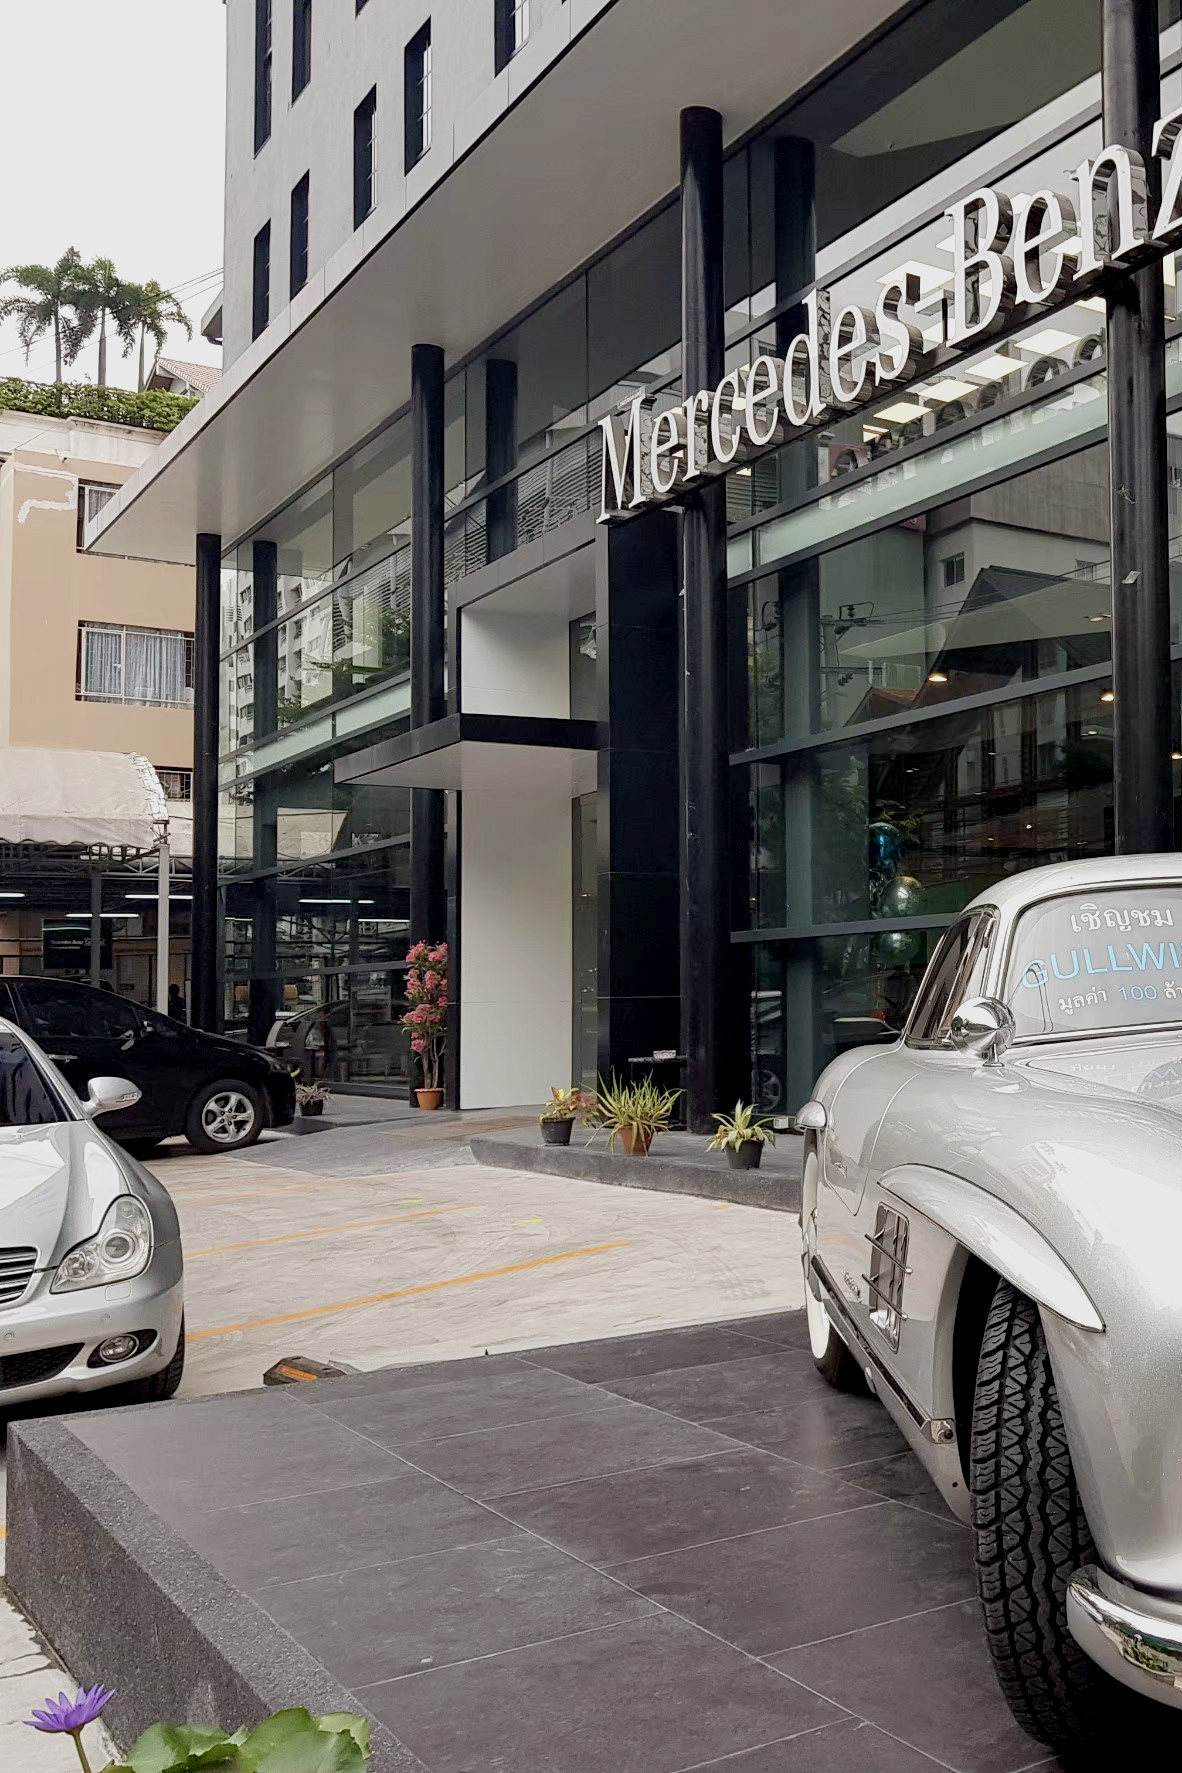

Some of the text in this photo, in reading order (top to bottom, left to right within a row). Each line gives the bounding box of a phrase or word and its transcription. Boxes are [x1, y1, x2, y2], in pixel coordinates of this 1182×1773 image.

[1070, 903, 1174, 933] เชิญชม
[1058, 986, 1108, 1015] มูลค่า
[1118, 984, 1157, 1001] 100
